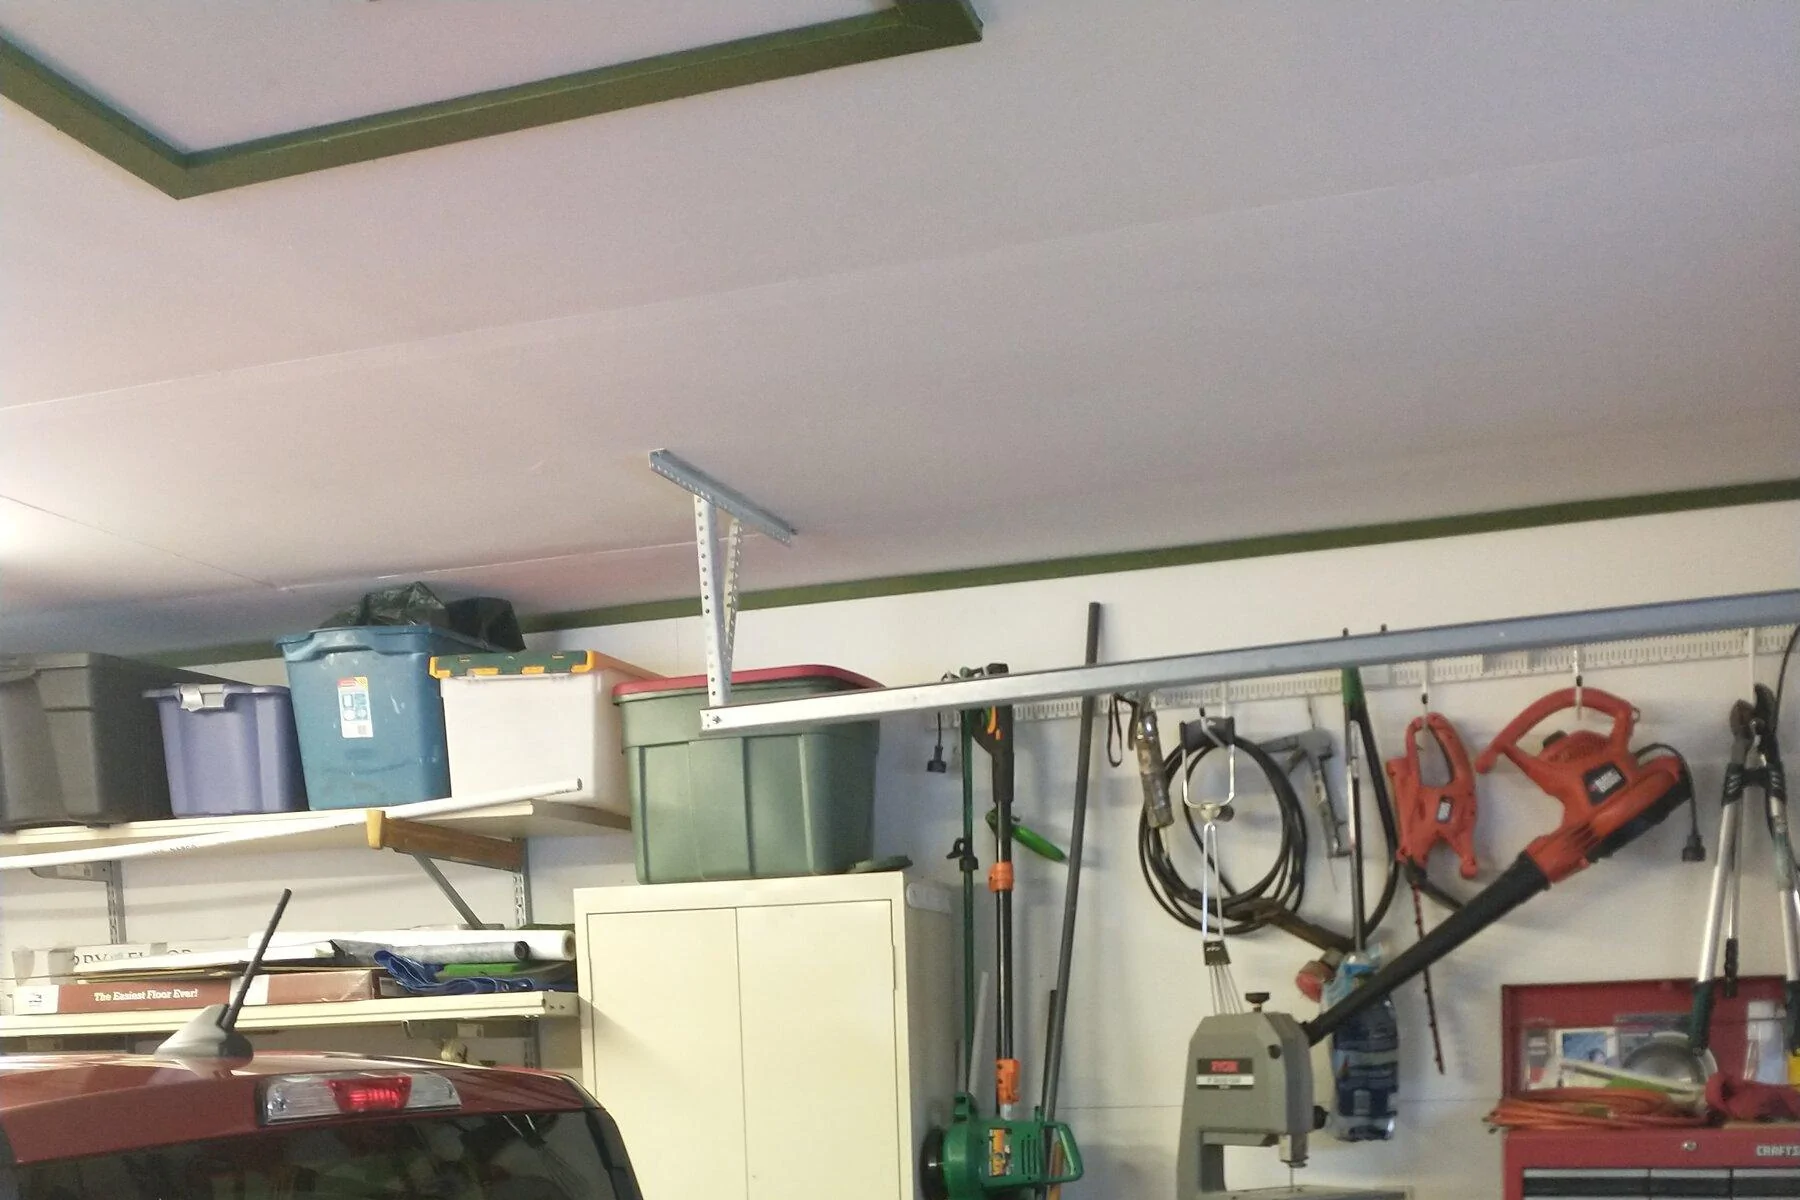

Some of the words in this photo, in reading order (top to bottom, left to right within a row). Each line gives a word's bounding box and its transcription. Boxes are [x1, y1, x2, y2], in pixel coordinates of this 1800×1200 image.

[94, 992, 112, 1002] The
[113, 991, 146, 1001] Easiest
[147, 989, 172, 1000] Floor
[173, 988, 198, 999] Ever!
